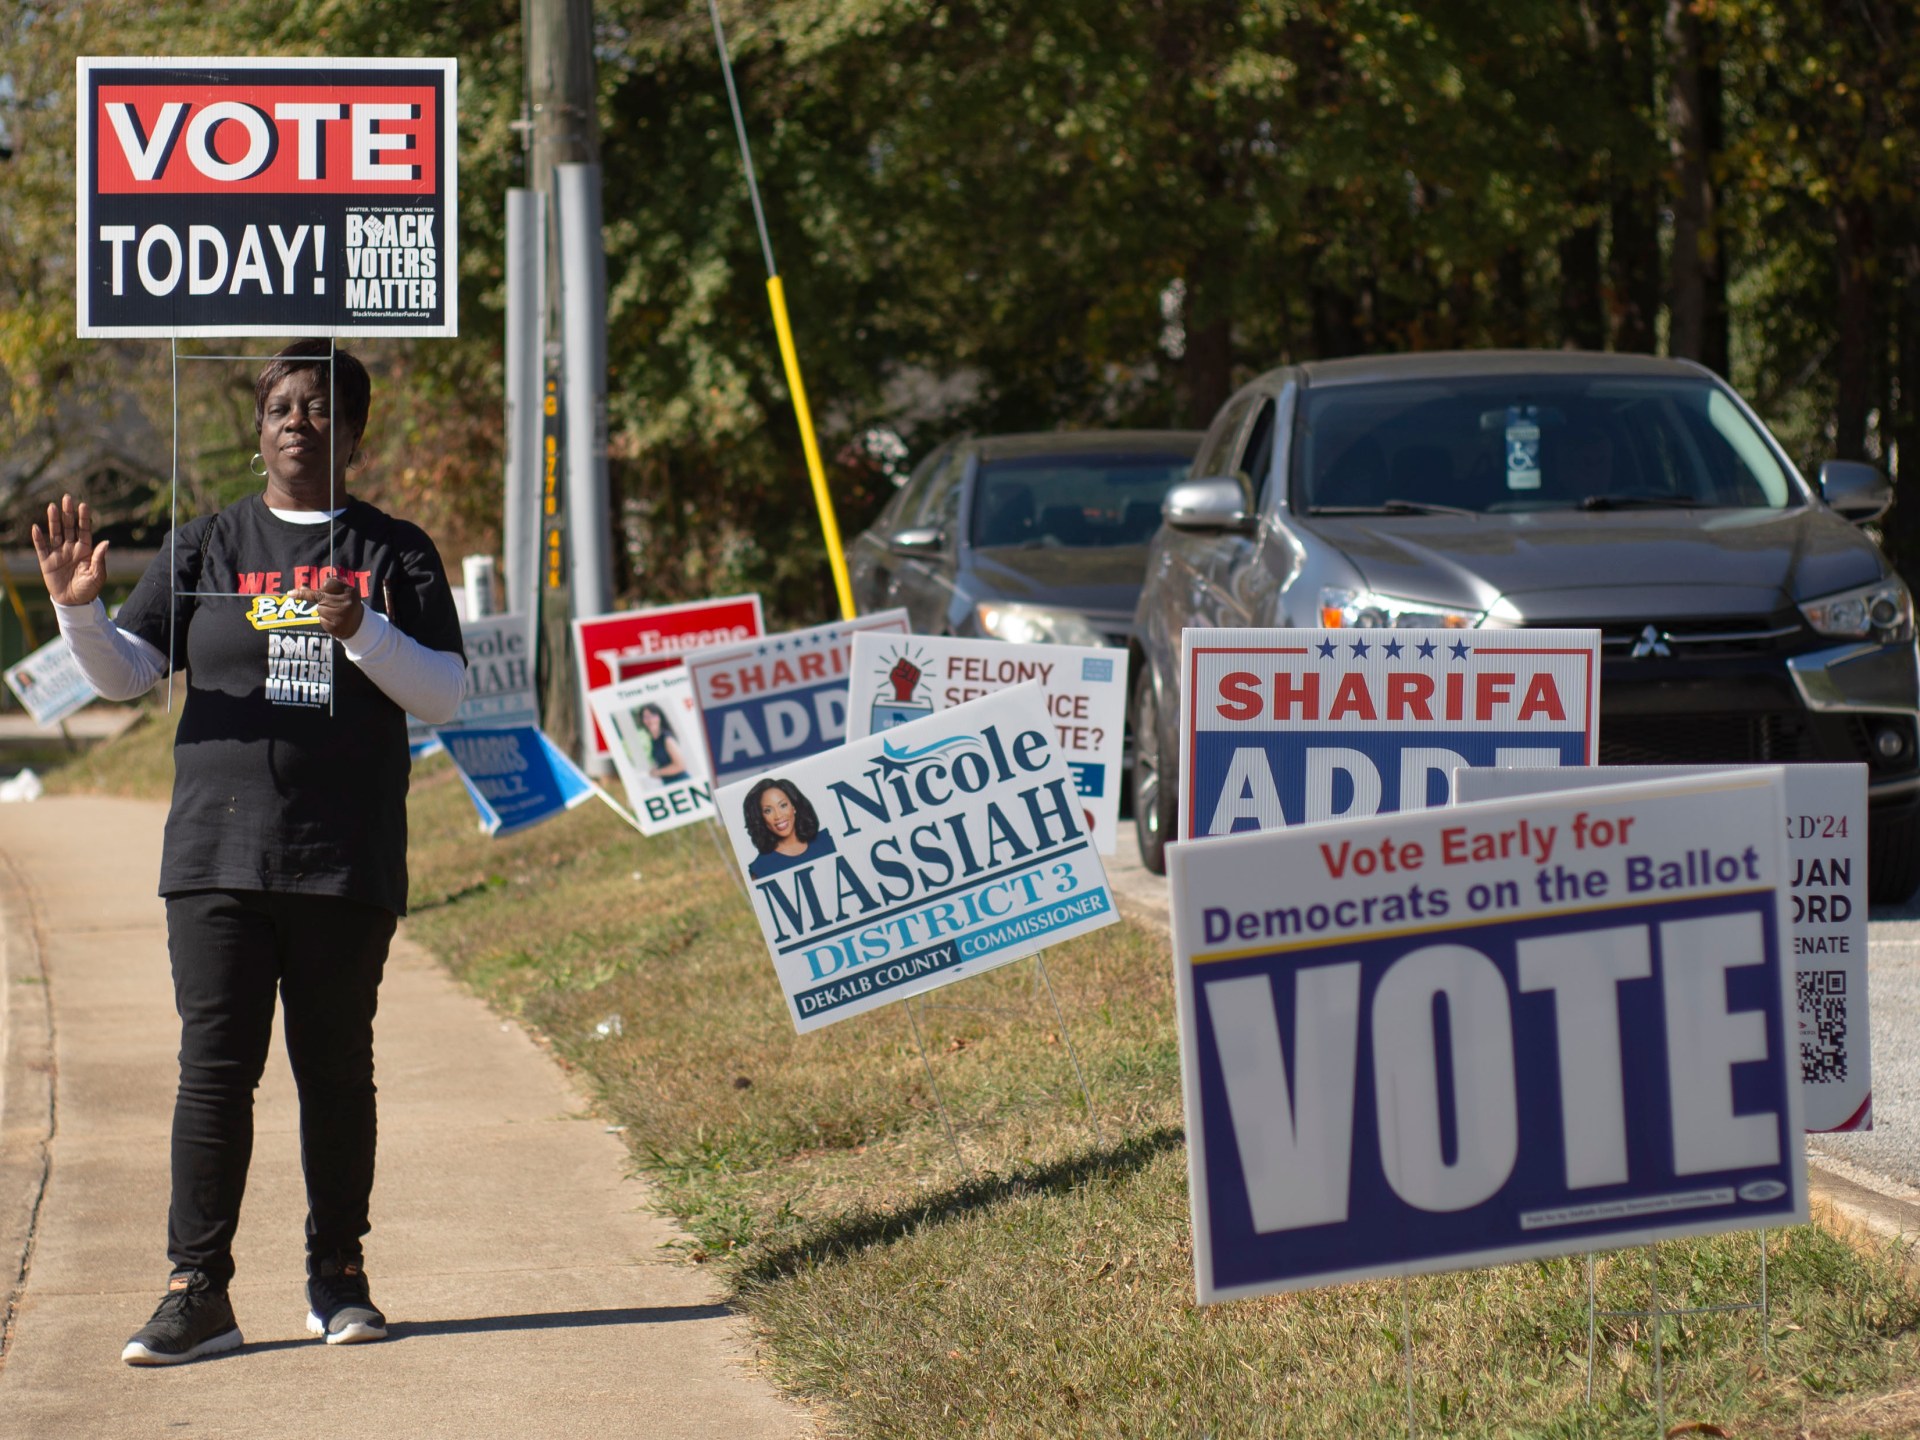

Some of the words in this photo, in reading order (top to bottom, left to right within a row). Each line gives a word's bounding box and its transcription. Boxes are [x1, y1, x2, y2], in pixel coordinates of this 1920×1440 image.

[105, 101, 421, 181] VOTE
[100, 224, 326, 296] TODAY!
[346, 247, 436, 278] VOTERS
[345, 279, 437, 309] MATTER
[238, 571, 281, 594] WE
[268, 658, 331, 683] VOTERS
[464, 629, 523, 659] cole
[947, 657, 1055, 686] FELONY
[265, 678, 330, 704] MATTER
[1215, 671, 1567, 721] SHARIFA
[827, 725, 1052, 837] Nicole
[756, 778, 1083, 944] MASSIAH
[1320, 841, 1424, 879] Vote
[1442, 820, 1557, 865] Early
[1574, 813, 1635, 850] for
[802, 870, 1044, 982] DISTRICT
[1055, 863, 1078, 893] 3
[1203, 884, 1450, 946] Democrats
[1466, 880, 1519, 912] on
[1537, 865, 1608, 902] the
[1627, 846, 1759, 892] Ballot
[800, 976, 871, 1014] DEKALB
[876, 946, 953, 987] COUNTY
[961, 895, 1103, 956] COMMISSIONER
[1203, 910, 1781, 1235] VOTE
